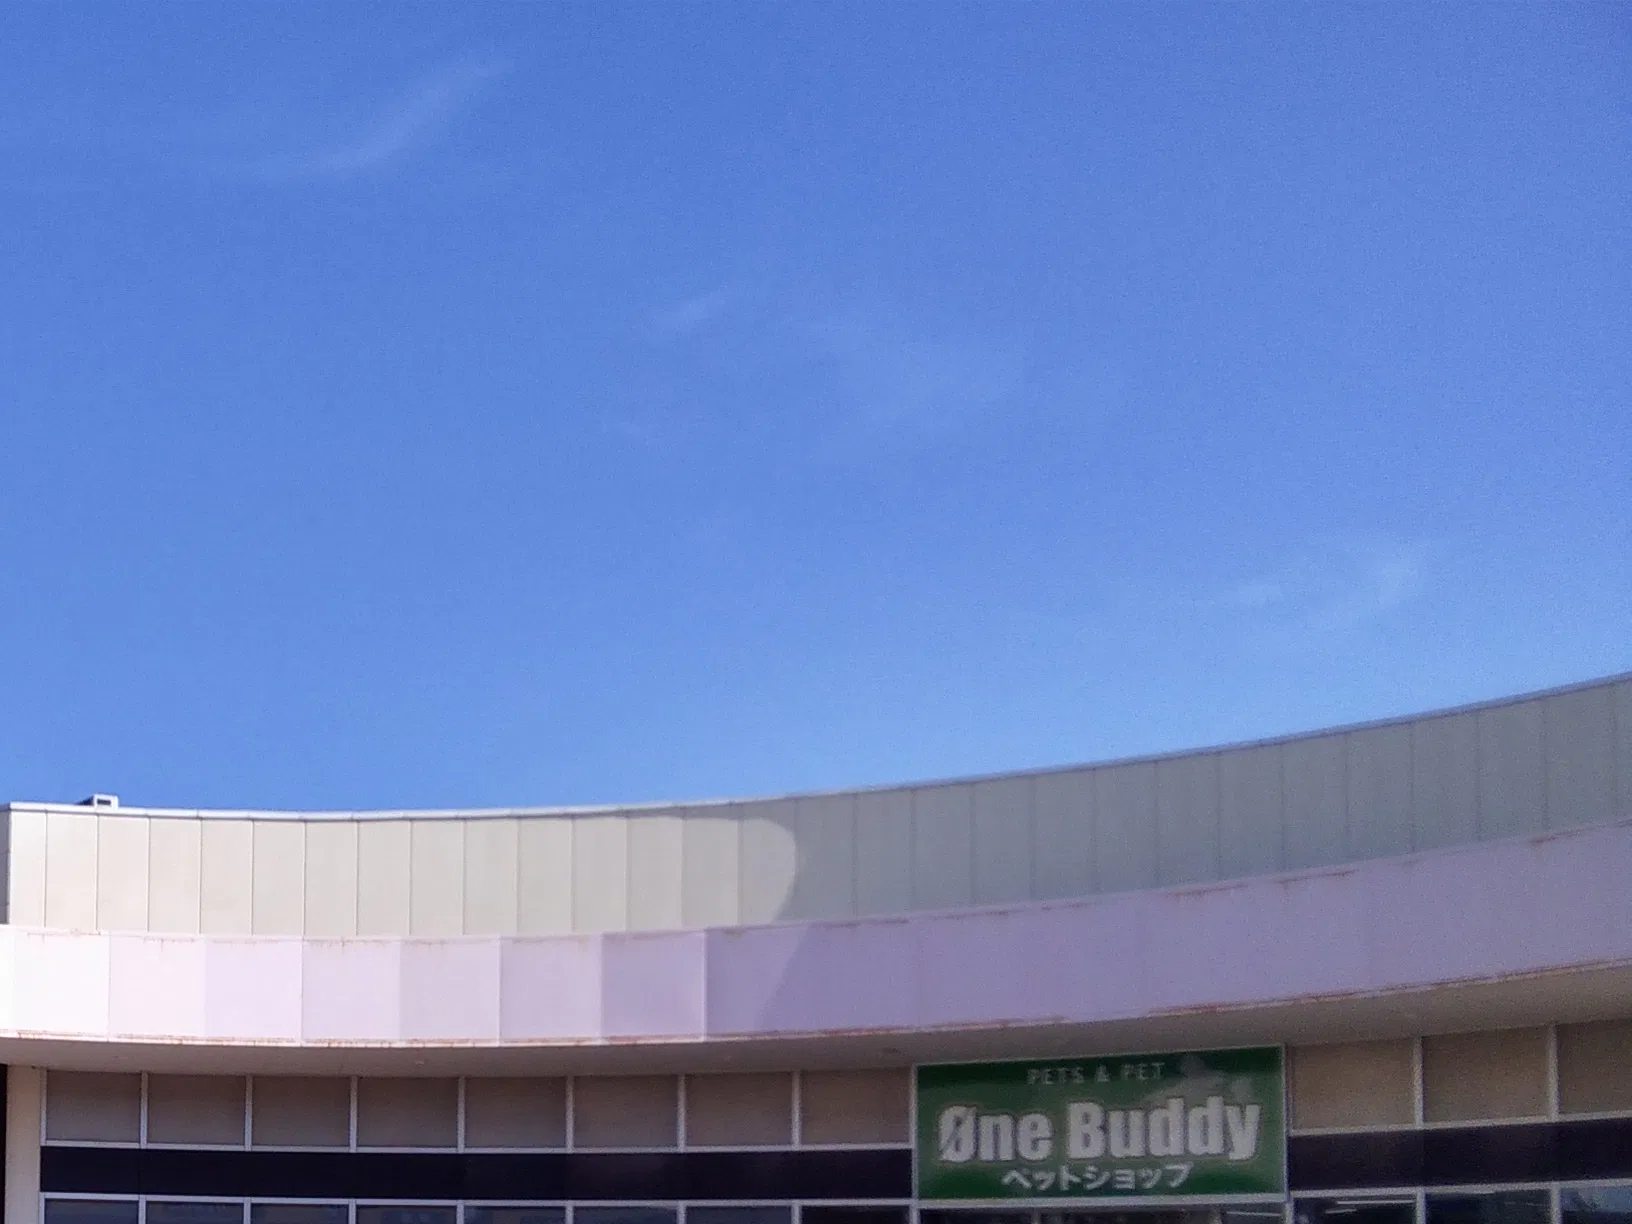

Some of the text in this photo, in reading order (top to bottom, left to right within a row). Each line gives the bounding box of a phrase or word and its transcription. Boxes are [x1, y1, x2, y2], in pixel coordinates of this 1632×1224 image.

[1027, 1067, 1085, 1085] PETS
[1120, 1063, 1165, 1081] PET
[1068, 1097, 1260, 1161] Buddy
